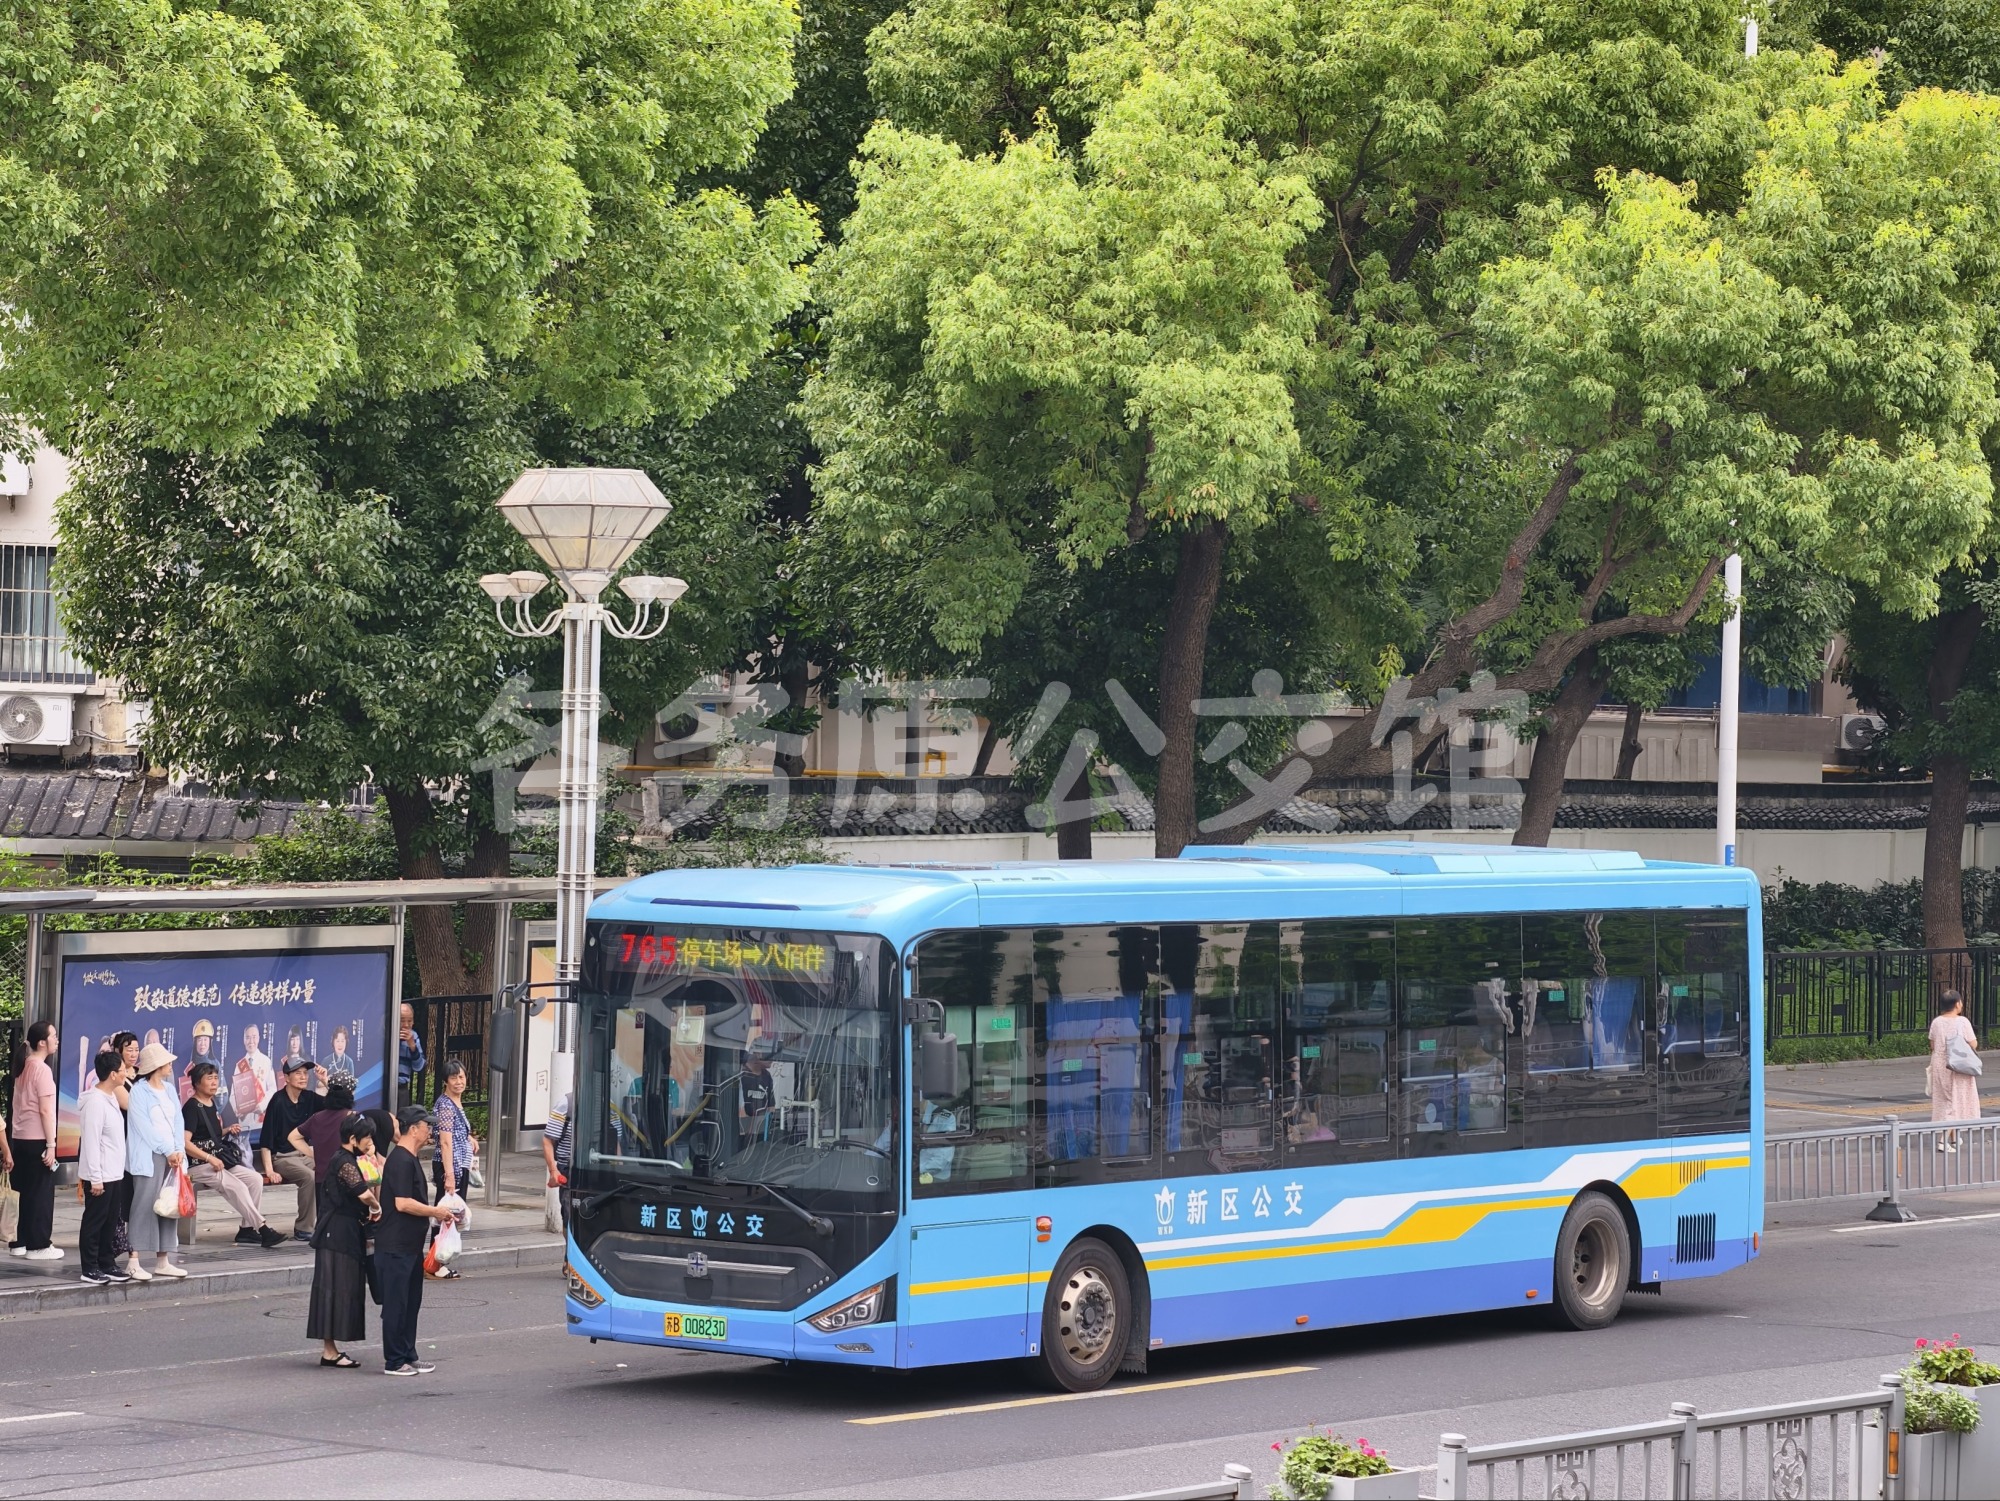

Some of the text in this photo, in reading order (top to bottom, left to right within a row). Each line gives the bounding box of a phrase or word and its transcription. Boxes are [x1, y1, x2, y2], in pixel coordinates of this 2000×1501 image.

[620, 933, 677, 965] 765
[133, 979, 317, 1013] 致敬道德模范 传递榜样力量
[1187, 1181, 1304, 1225] 新区公交
[640, 1204, 765, 1238] 新区 公交
[666, 1317, 726, 1337] 苏B00823D
